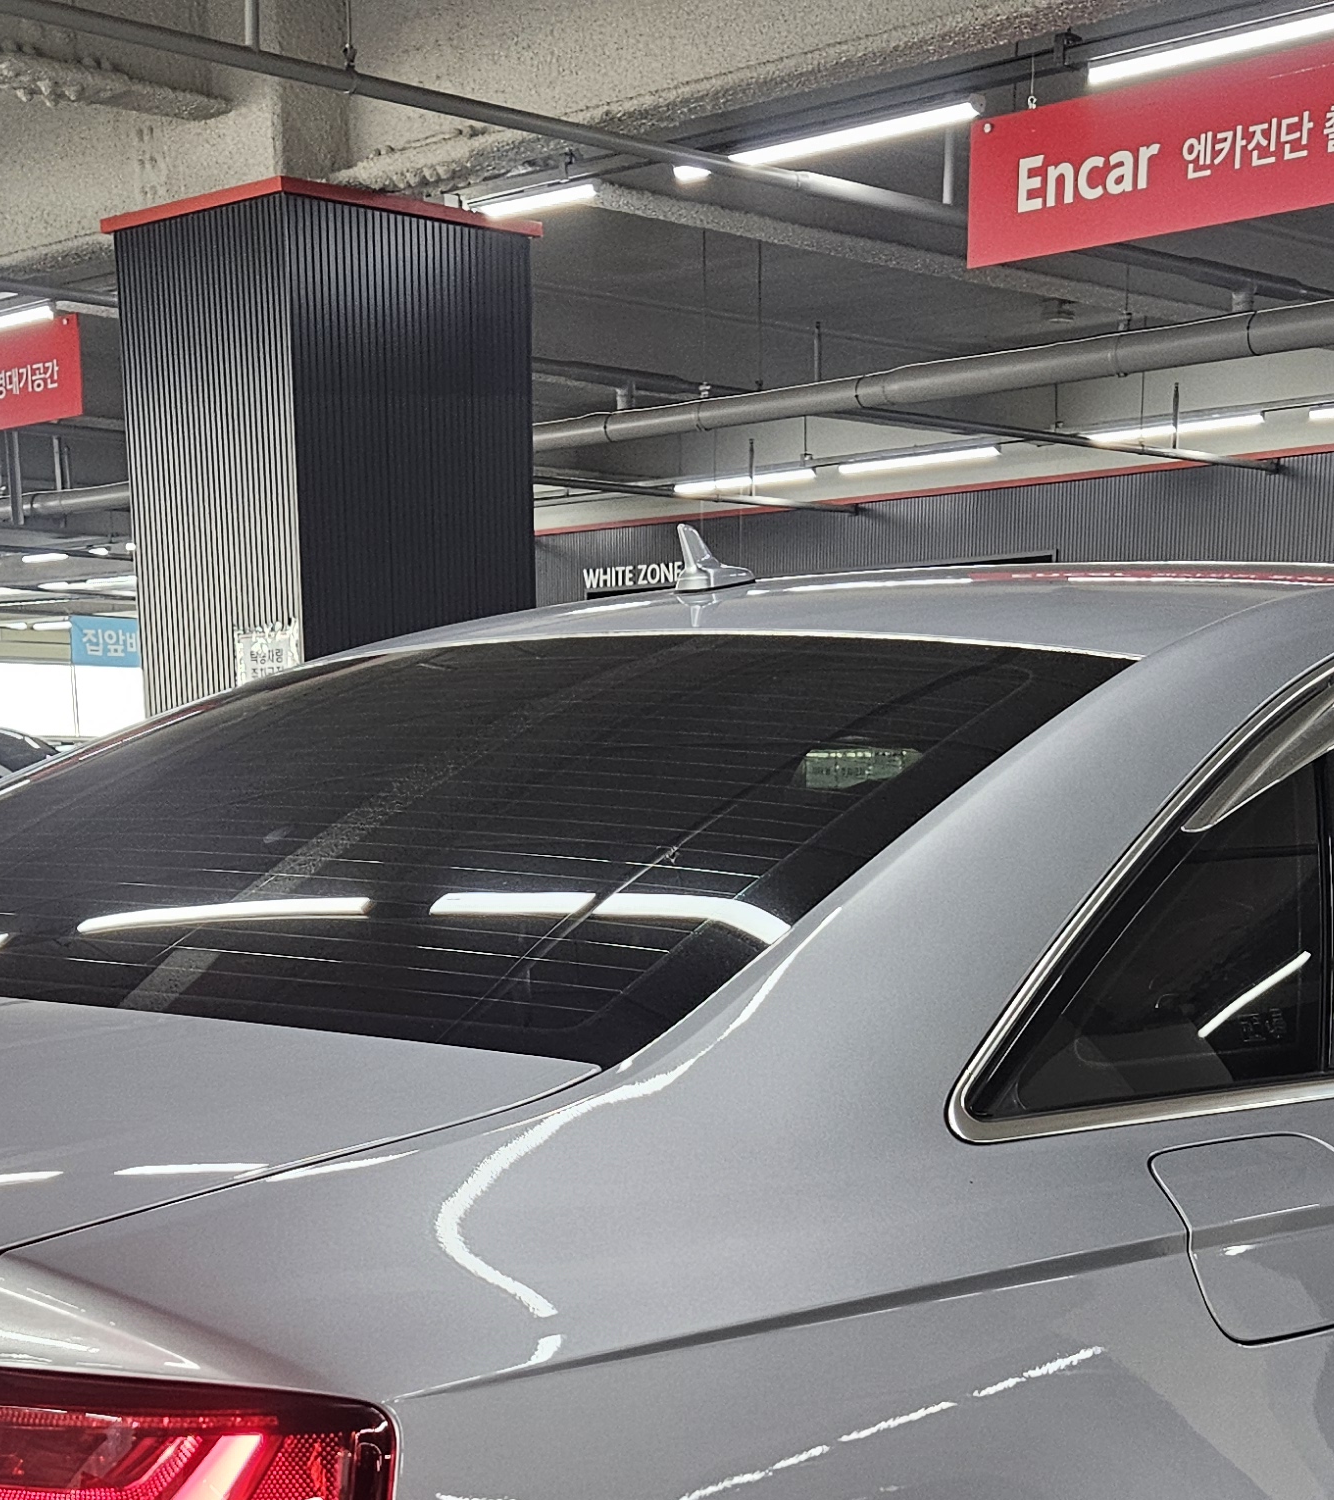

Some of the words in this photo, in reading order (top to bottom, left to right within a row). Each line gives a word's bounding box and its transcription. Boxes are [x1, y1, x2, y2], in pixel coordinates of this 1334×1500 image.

[1016, 141, 1161, 214] Encar
[1181, 110, 1314, 180] 엔카진단
[582, 565, 634, 589] WHITE
